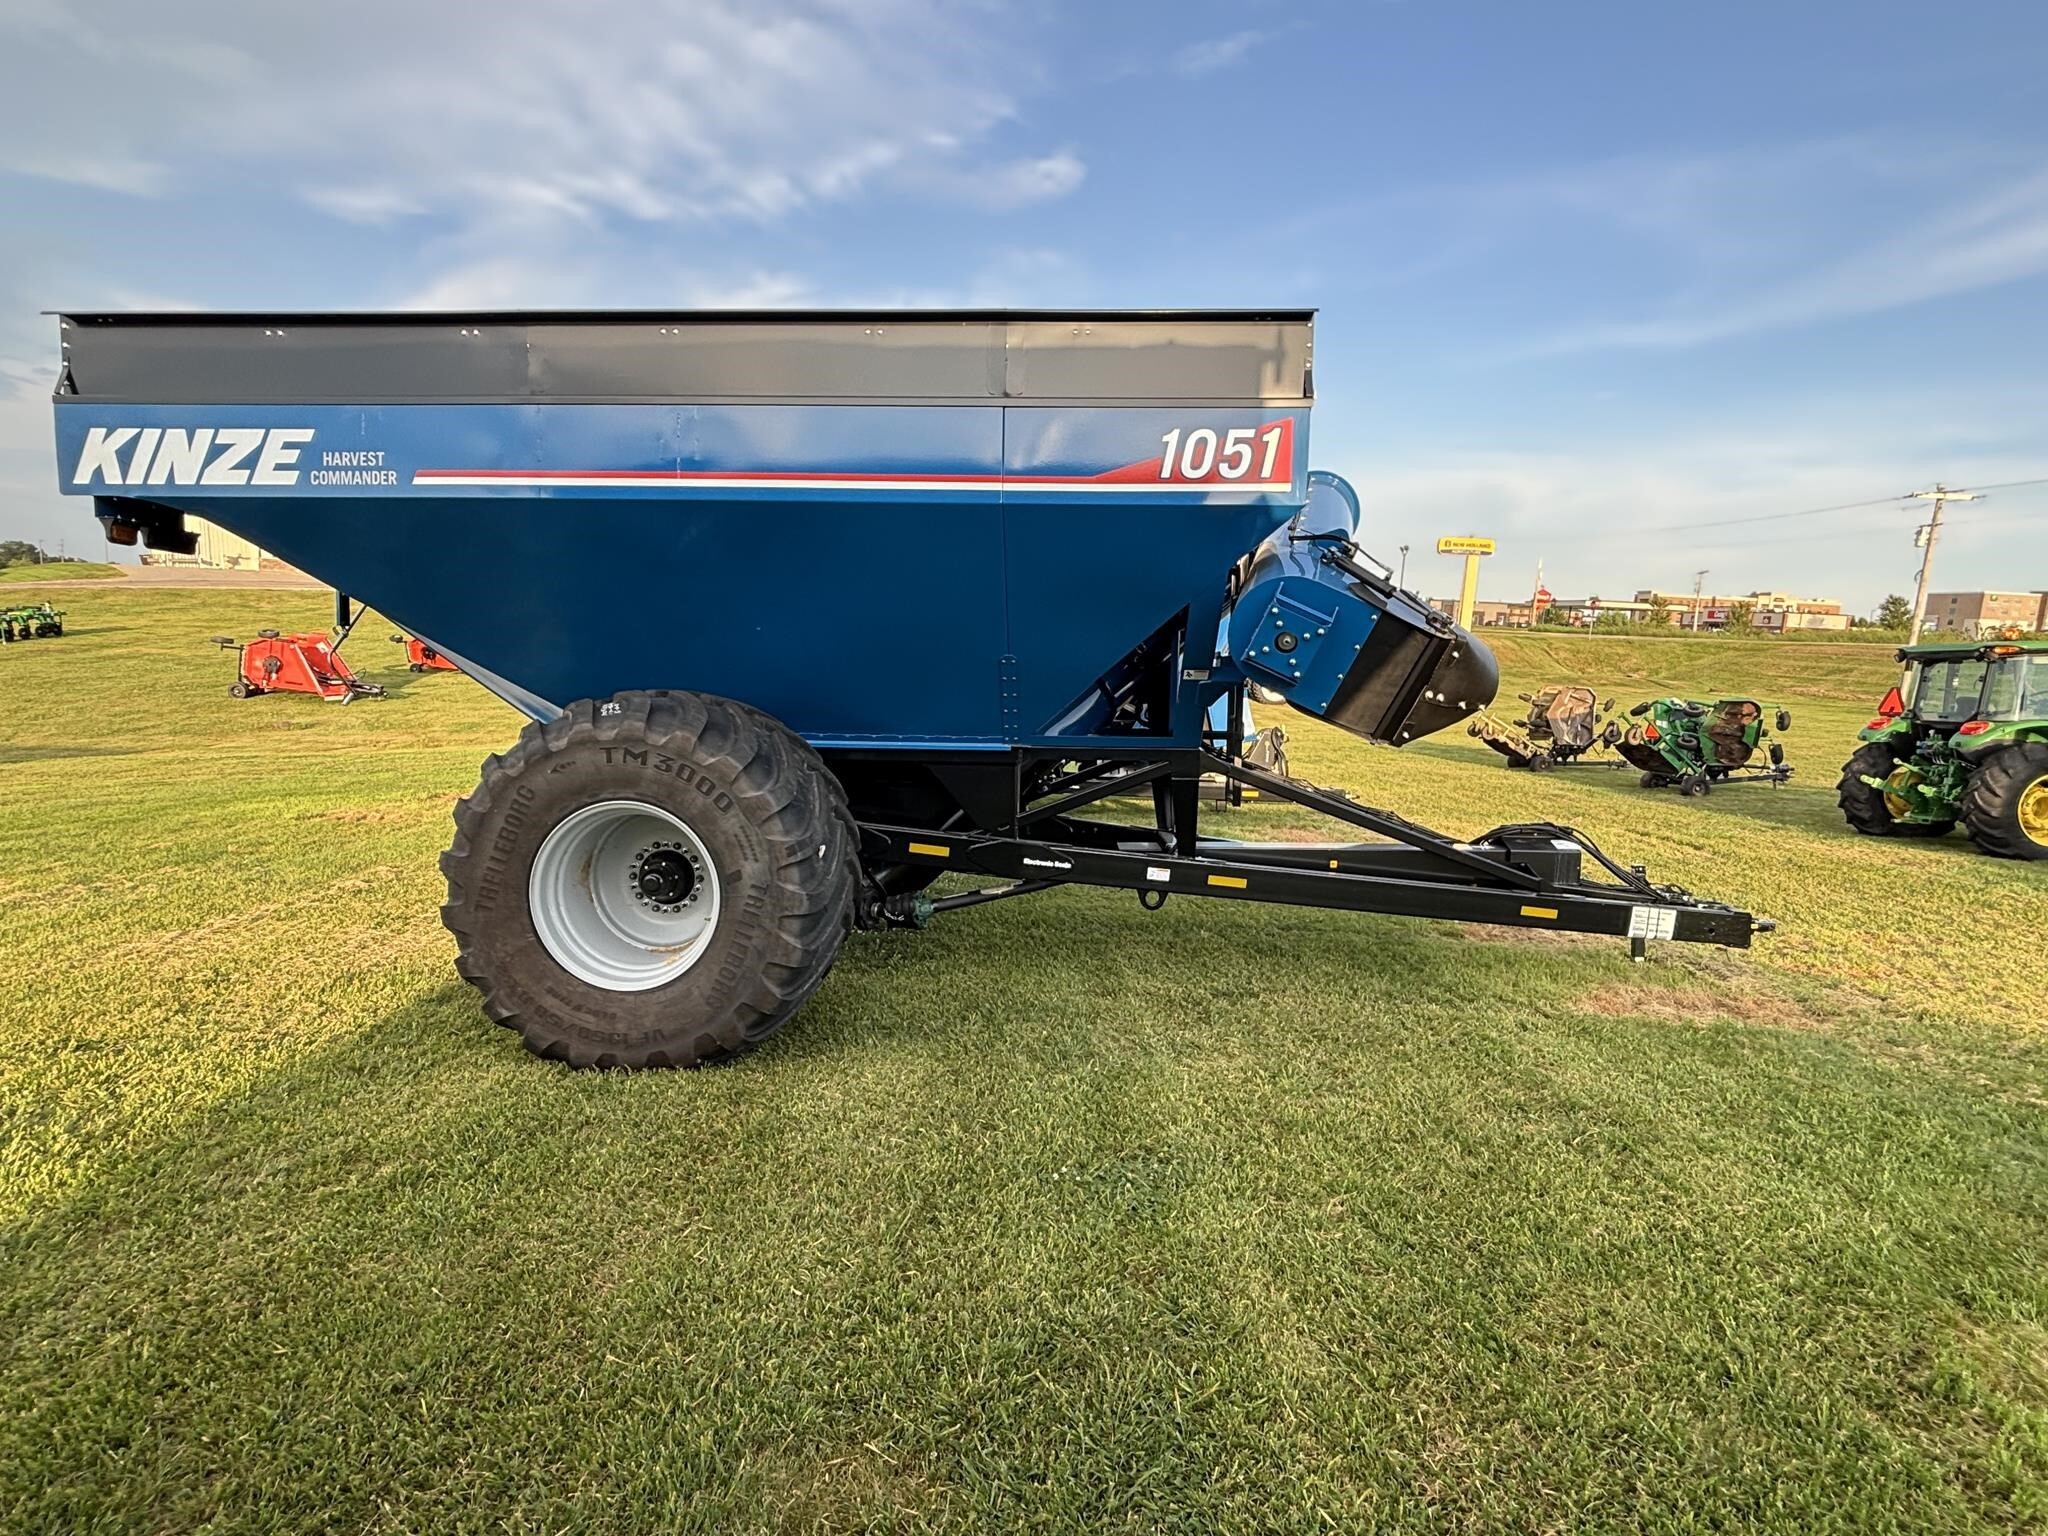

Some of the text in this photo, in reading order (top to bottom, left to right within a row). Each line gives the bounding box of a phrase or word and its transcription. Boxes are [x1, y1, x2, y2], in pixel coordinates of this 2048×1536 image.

[72, 427, 316, 485] KINZE
[310, 470, 398, 486] COMMANDER
[322, 451, 385, 467] HARVEST
[1160, 427, 1282, 479] 1051
[600, 746, 734, 813] TM3000
[474, 784, 536, 912] TRELLEBORG
